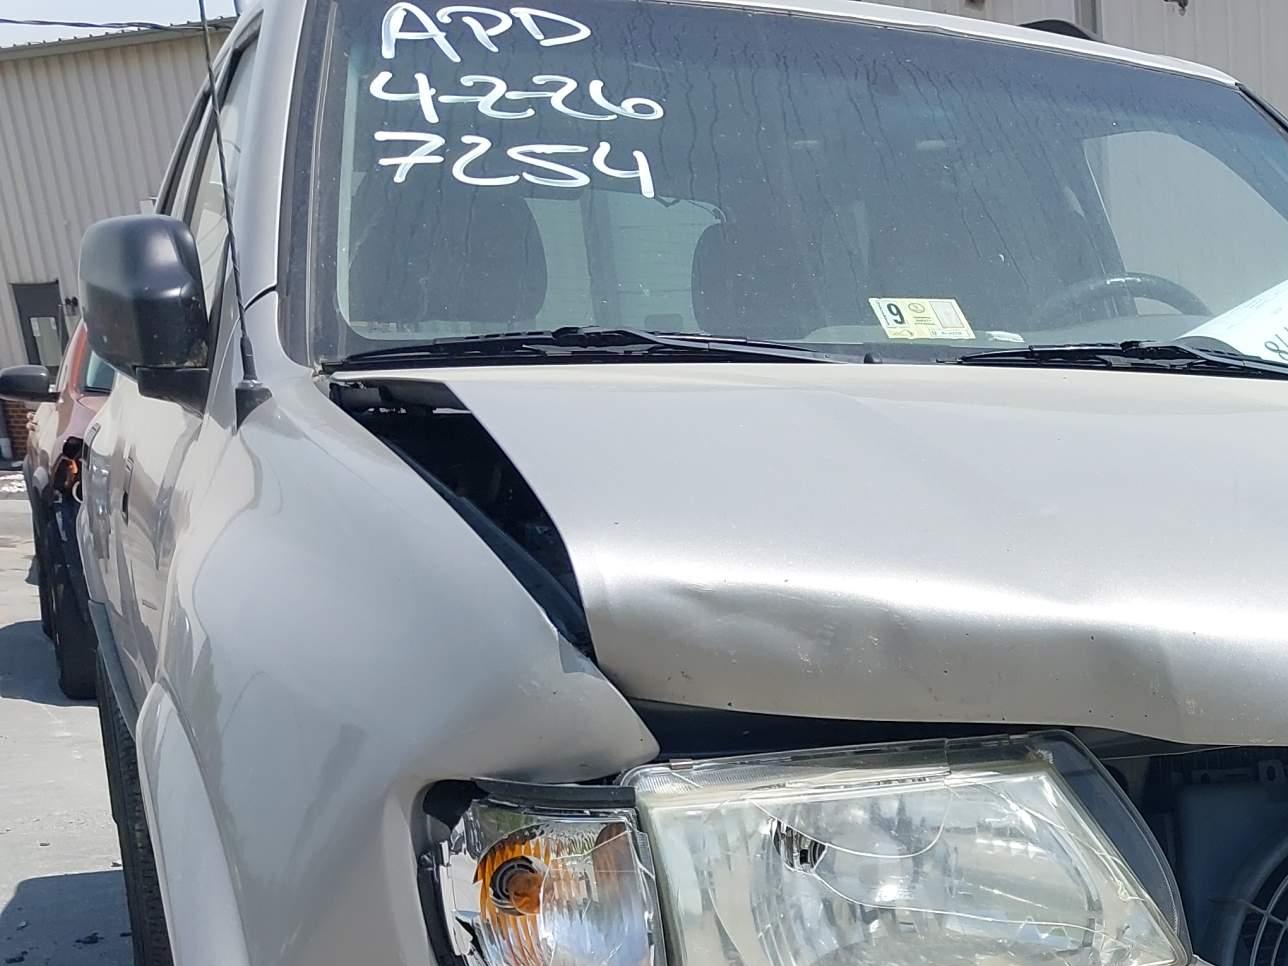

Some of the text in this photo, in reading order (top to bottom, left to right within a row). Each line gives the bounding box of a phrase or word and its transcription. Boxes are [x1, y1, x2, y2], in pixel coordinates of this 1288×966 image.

[381, 2, 592, 62] APD
[374, 131, 655, 198] 7254
[886, 303, 906, 325] 9
